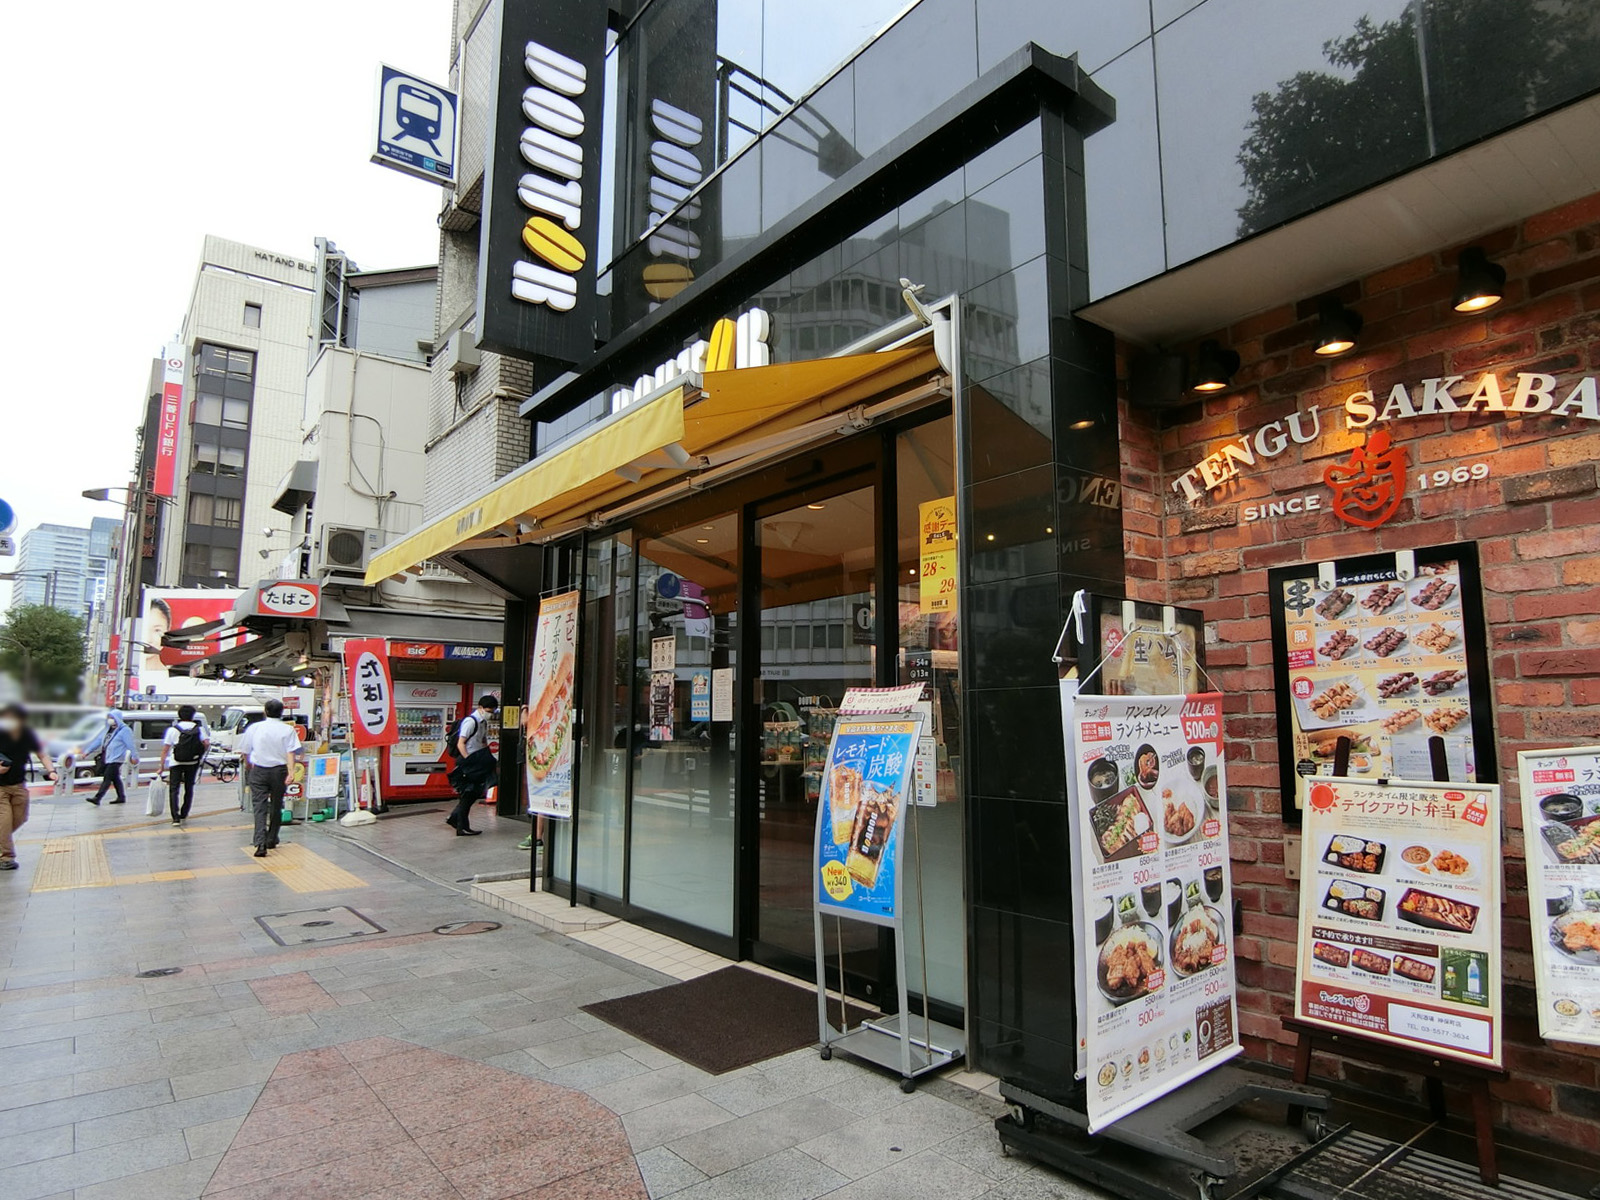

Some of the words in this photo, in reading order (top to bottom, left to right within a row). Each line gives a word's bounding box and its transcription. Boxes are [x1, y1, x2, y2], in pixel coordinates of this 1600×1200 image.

[511, 40, 587, 312] DOUTOR
[162, 394, 178, 456] 三菱UFJ銀行
[1172, 405, 1320, 504] TENGU
[1345, 372, 1600, 430] SAKABA
[1244, 494, 1320, 521] SINCE
[1417, 463, 1489, 490] 1969
[924, 519, 956, 534] 感謝デー
[923, 562, 937, 577] 28
[940, 578, 955, 594] 29
[266, 591, 311, 606] たばこ
[1285, 580, 1315, 618] 串
[566, 612, 575, 647] エビ、
[407, 645, 427, 655] BIG
[1134, 637, 1177, 663] 生ハム
[360, 659, 385, 727] たばこ
[1125, 704, 1171, 720] ワンコイン
[1181, 702, 1201, 718] ALL
[1116, 721, 1179, 740] ランチメニュー
[866, 752, 903, 780] 炭酸
[1353, 790, 1439, 803] ランチタイム限定販売
[1341, 799, 1456, 819] テイクアウト弁当
[1467, 808, 1485, 819] TAKE
[1466, 814, 1482, 824] OUT
[1438, 1018, 1462, 1028] 神保町店
[1421, 1026, 1470, 1040] 03-5577-3634
